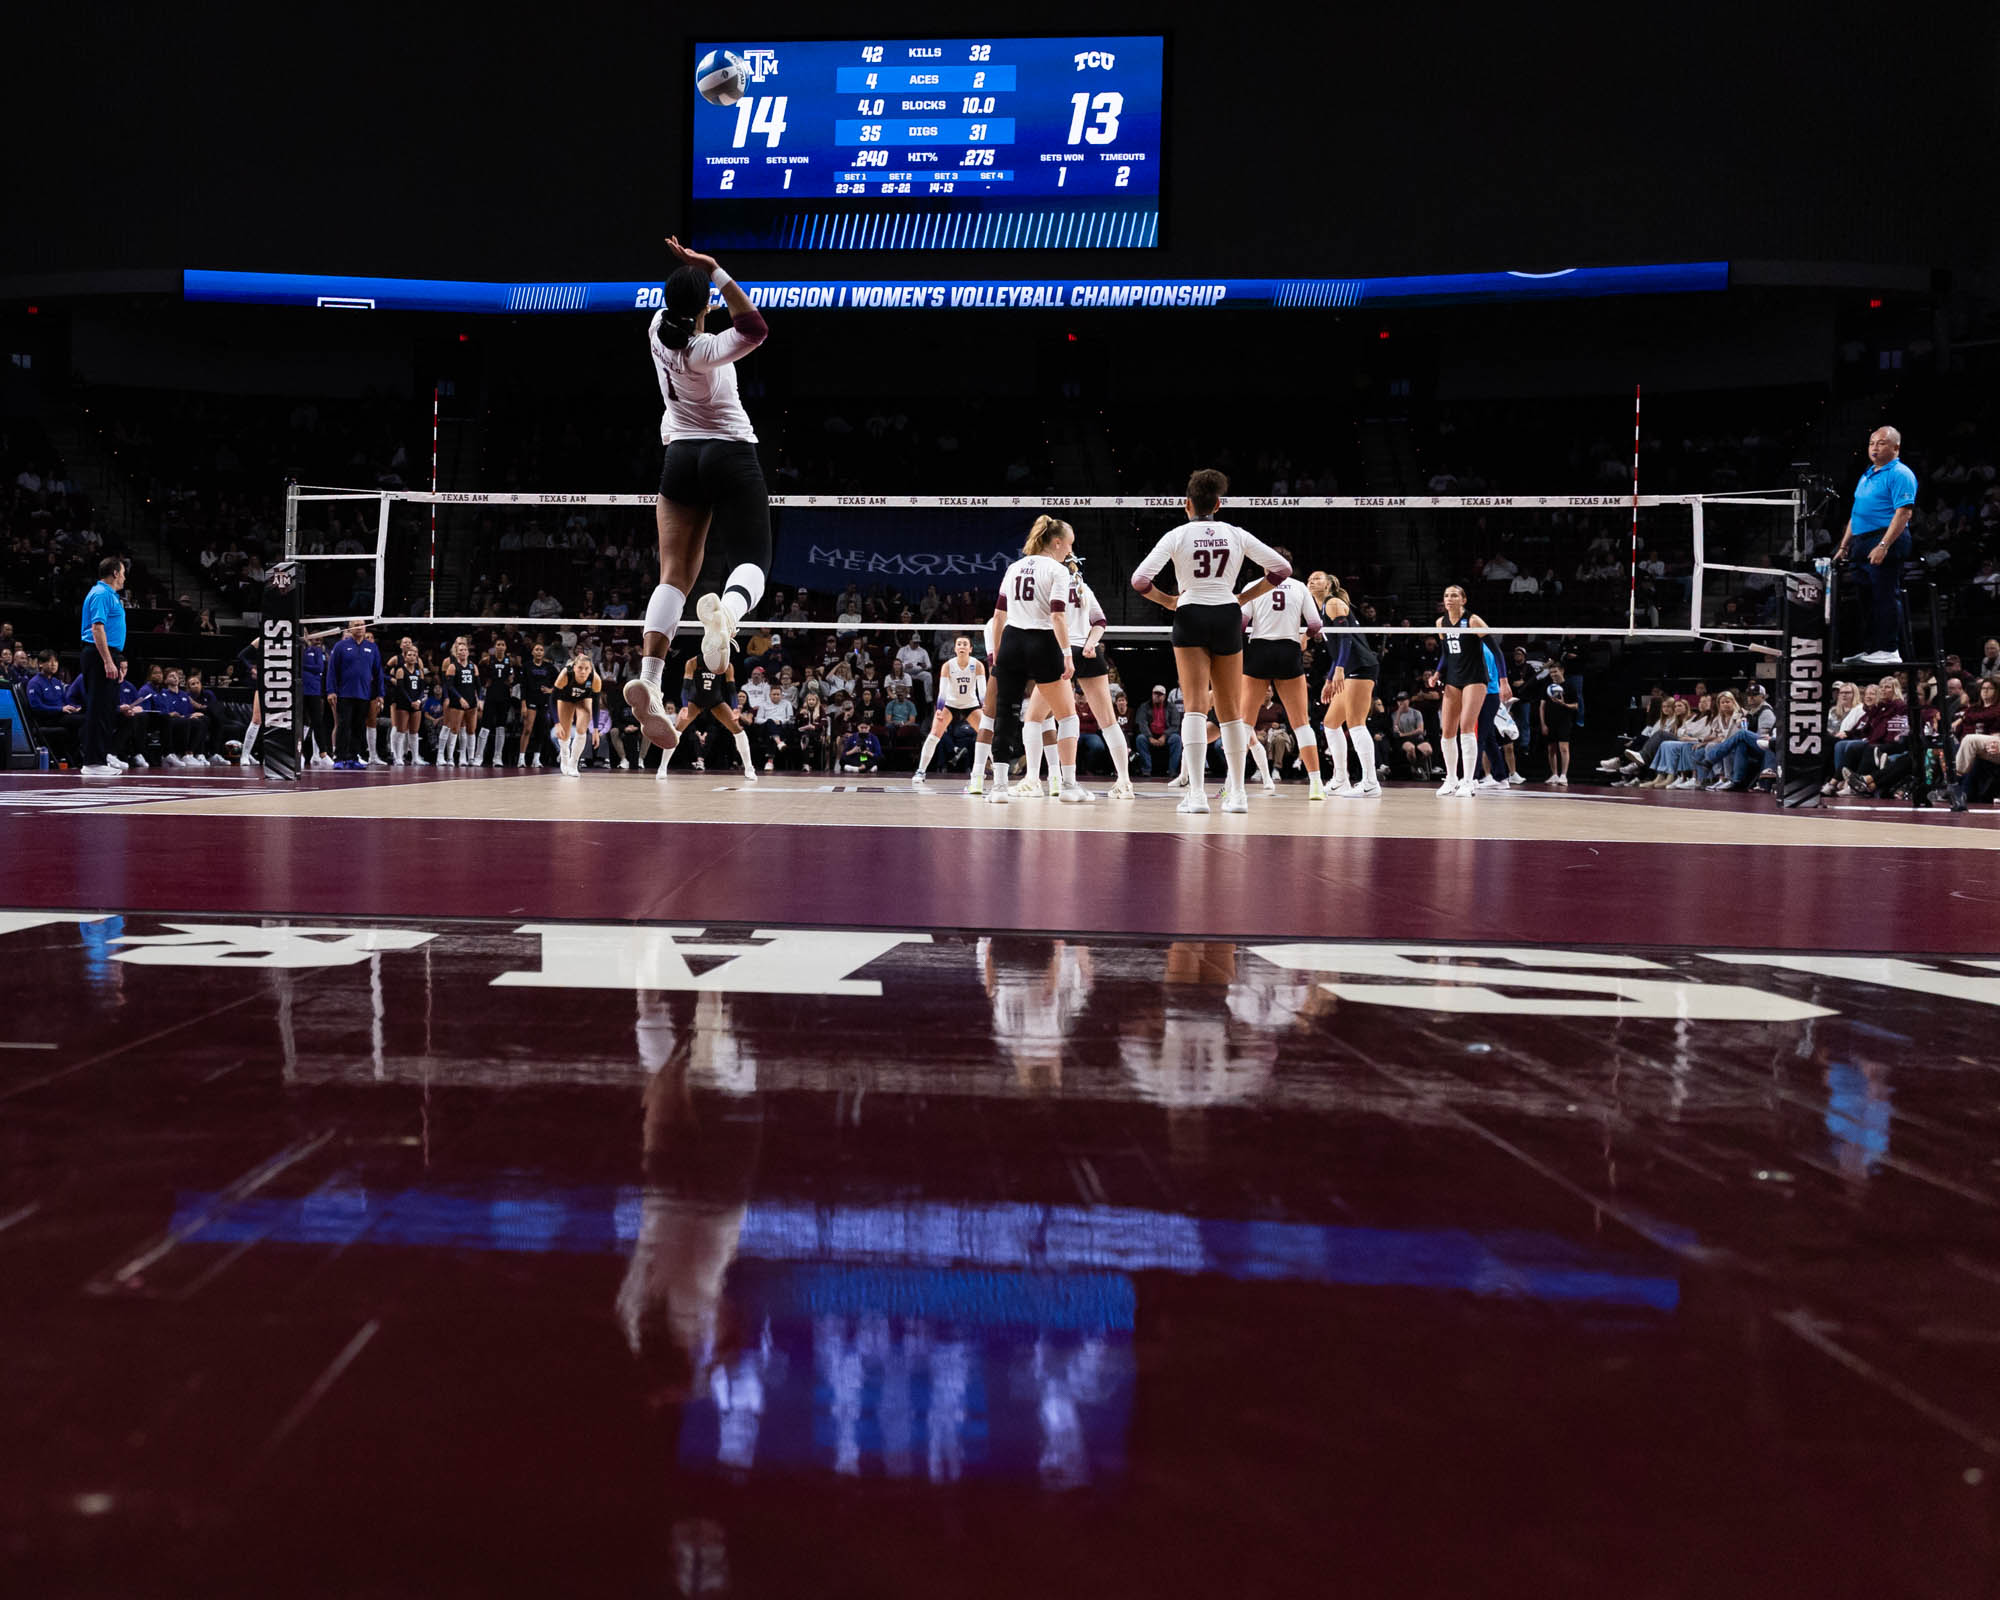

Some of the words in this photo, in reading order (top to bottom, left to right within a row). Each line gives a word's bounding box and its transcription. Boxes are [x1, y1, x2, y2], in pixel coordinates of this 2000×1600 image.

[862, 45, 884, 63] 42
[908, 47, 942, 58] KILLS
[969, 44, 992, 62] 32
[1074, 51, 1116, 72] TCU
[866, 72, 878, 89] 4
[909, 74, 940, 85] ACES
[972, 71, 986, 88] 2
[857, 98, 885, 116] 4.0
[902, 100, 947, 111] BLOCKS
[962, 96, 995, 114] 10.0
[732, 96, 788, 149] 14
[1067, 91, 1124, 145] 13
[860, 124, 882, 142] 35
[908, 126, 938, 137] DIGS
[969, 123, 987, 141] 31
[705, 156, 750, 165] TIMEOUTS
[766, 156, 788, 164] SETS
[789, 156, 809, 164] WON
[851, 150, 889, 167] .240
[907, 152, 938, 162] HIT%
[959, 149, 995, 166] .275
[1040, 153, 1062, 162] SETS
[1064, 153, 1084, 162] WON
[1099, 153, 1146, 161] TIMEOUTS
[719, 169, 735, 190] 2
[783, 168, 793, 190] 1
[844, 173, 860, 181] SET
[889, 173, 905, 181] SET
[934, 172, 950, 180] SET
[952, 172, 959, 180] 3
[980, 172, 996, 180] SET
[1057, 166, 1067, 187] 1
[1114, 166, 1130, 187] 2
[835, 183, 866, 194] 23-25
[881, 183, 911, 193] 25-22
[929, 183, 954, 193] 14-13
[749, 287, 831, 308] DIVISION
[838, 287, 847, 307] I
[851, 286, 946, 307] WOMEN'S
[950, 286, 1065, 307] VOLLEYBALL
[1070, 285, 1227, 307] CHAMPIONSHIP
[663, 367, 679, 402] 1
[441, 493, 470, 502] TEXAS
[539, 494, 567, 503] TEXAS
[837, 497, 866, 505] TEXAS
[938, 497, 968, 505] TEXAS
[1041, 497, 1071, 506] TEXAS
[1144, 498, 1174, 506] TEXAS
[1249, 497, 1279, 506] TEXAS
[1354, 498, 1384, 506] TEXAS
[1460, 498, 1491, 506] TEXAS
[1568, 497, 1599, 505] TEXAS
[1193, 538, 1229, 548] STOWERS
[808, 544, 1026, 566] MEMORIA
[1193, 548, 1230, 579] 37
[1015, 576, 1035, 602] 16
[1272, 591, 1286, 611] 9
[1447, 640, 1461, 654] 19
[264, 619, 293, 730] AGGIES
[461, 675, 473, 684] 33
[702, 672, 716, 680] TCU
[703, 680, 713, 690] 2
[1789, 636, 1823, 755] AGGIES
